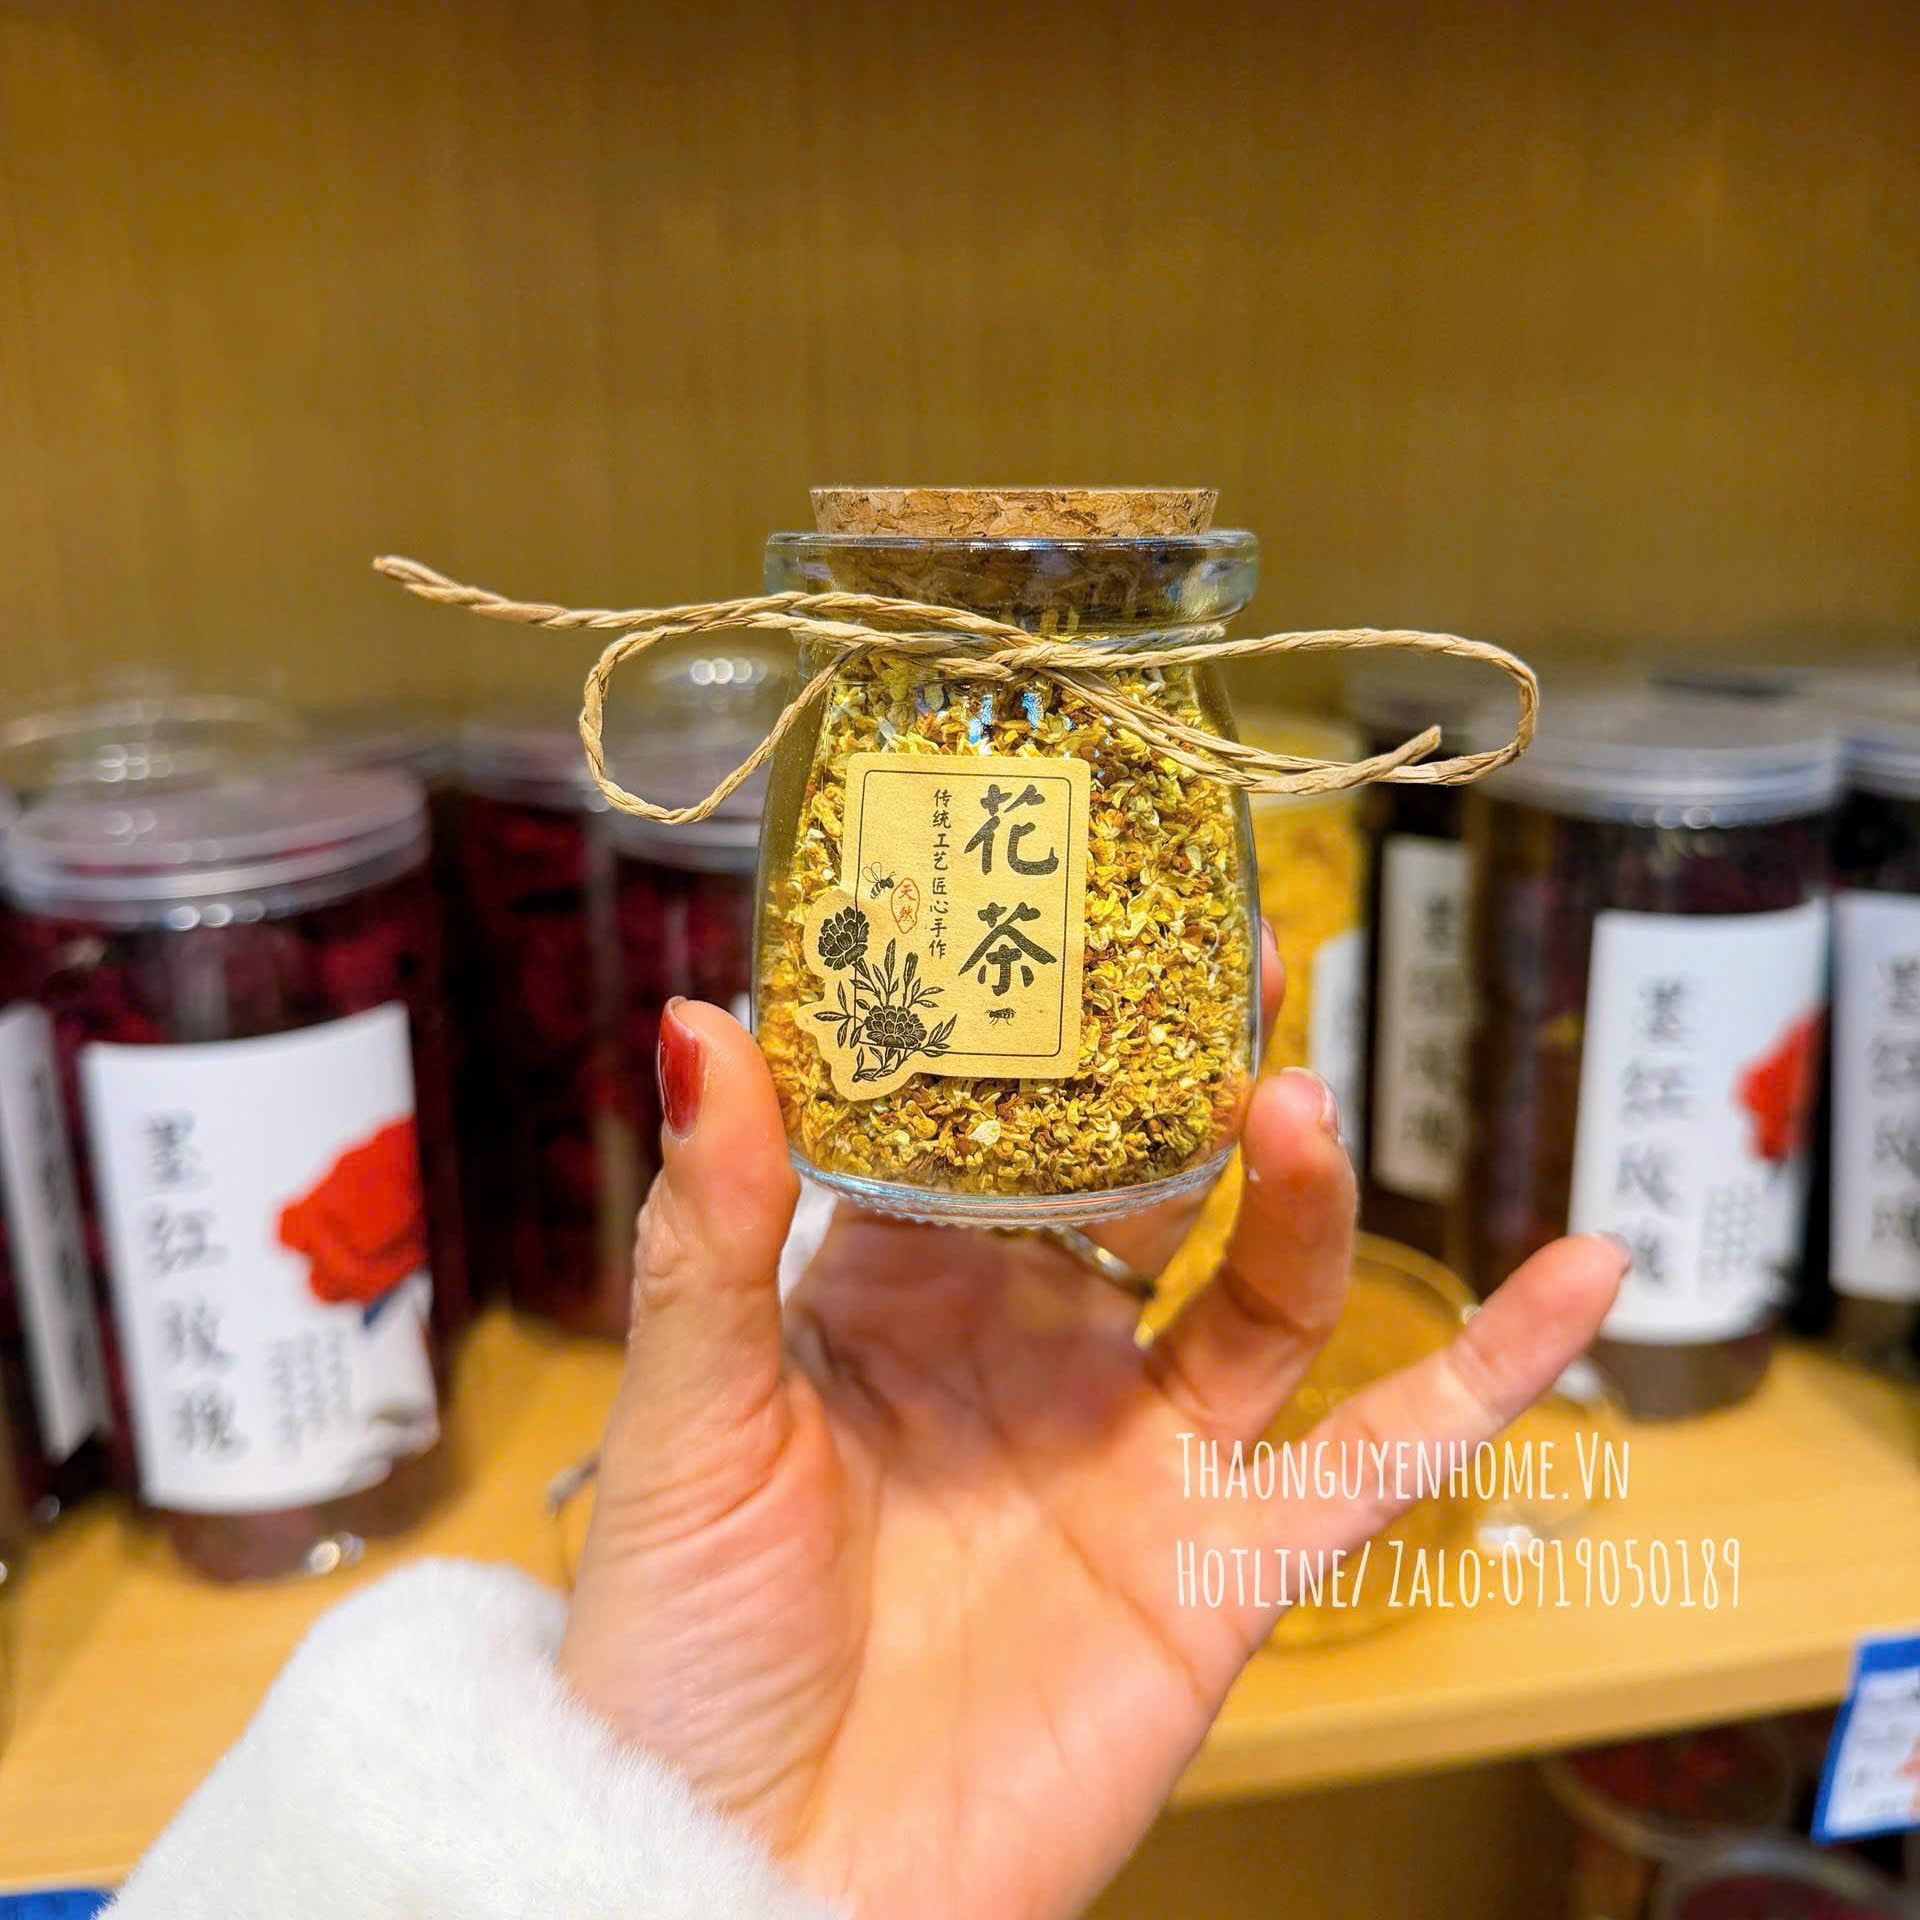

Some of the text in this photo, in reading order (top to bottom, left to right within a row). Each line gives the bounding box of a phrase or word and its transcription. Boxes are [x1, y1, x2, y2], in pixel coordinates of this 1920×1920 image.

[898, 884, 916, 925] 天然
[928, 788, 953, 960] 传统工艺匠心手作
[957, 784, 1060, 997] 花茶
